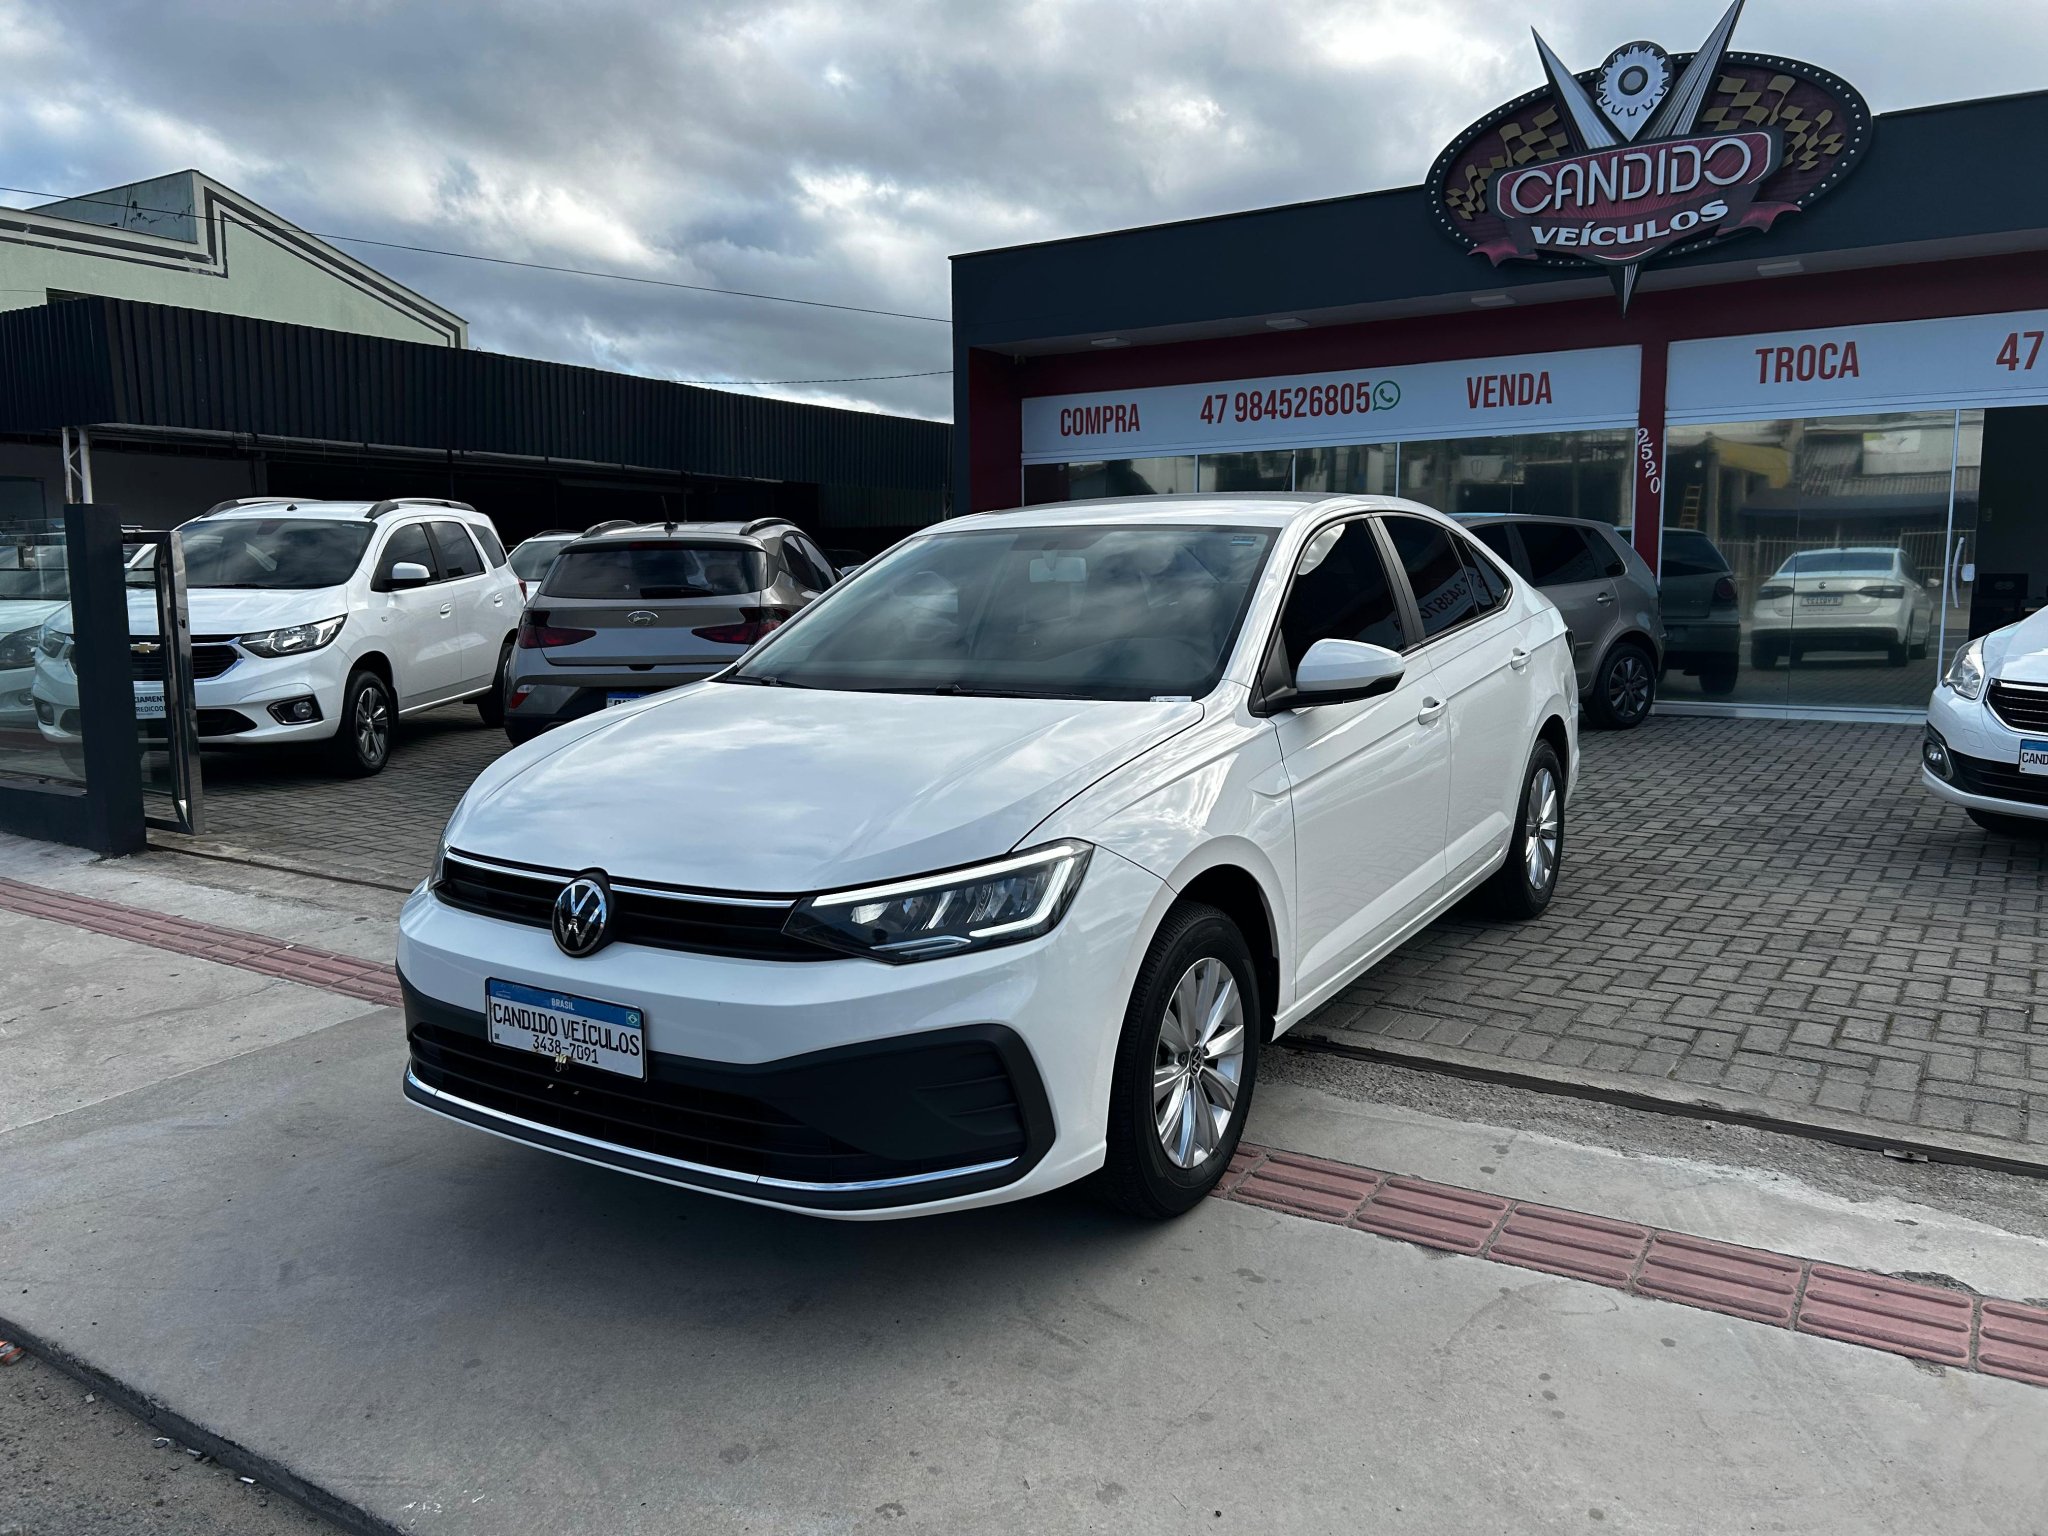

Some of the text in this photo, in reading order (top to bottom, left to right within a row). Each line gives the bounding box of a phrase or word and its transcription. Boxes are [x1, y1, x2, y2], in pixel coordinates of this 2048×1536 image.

[1510, 137, 1752, 215] CANDIDO
[1531, 199, 1729, 246] VEÍCULOS
[1755, 341, 1860, 384] TROCA
[1996, 331, 2046, 372] 47
[1200, 381, 1371, 425] 47 984526805
[1467, 371, 1553, 409] VENDA
[1060, 403, 1141, 437] COMPRA
[1637, 427, 1661, 494] 2520
[551, 998, 575, 1011] BRASIL
[493, 1003, 640, 1056] CANDIDO VEÍCULOS
[532, 1034, 599, 1064] 3438-7091
